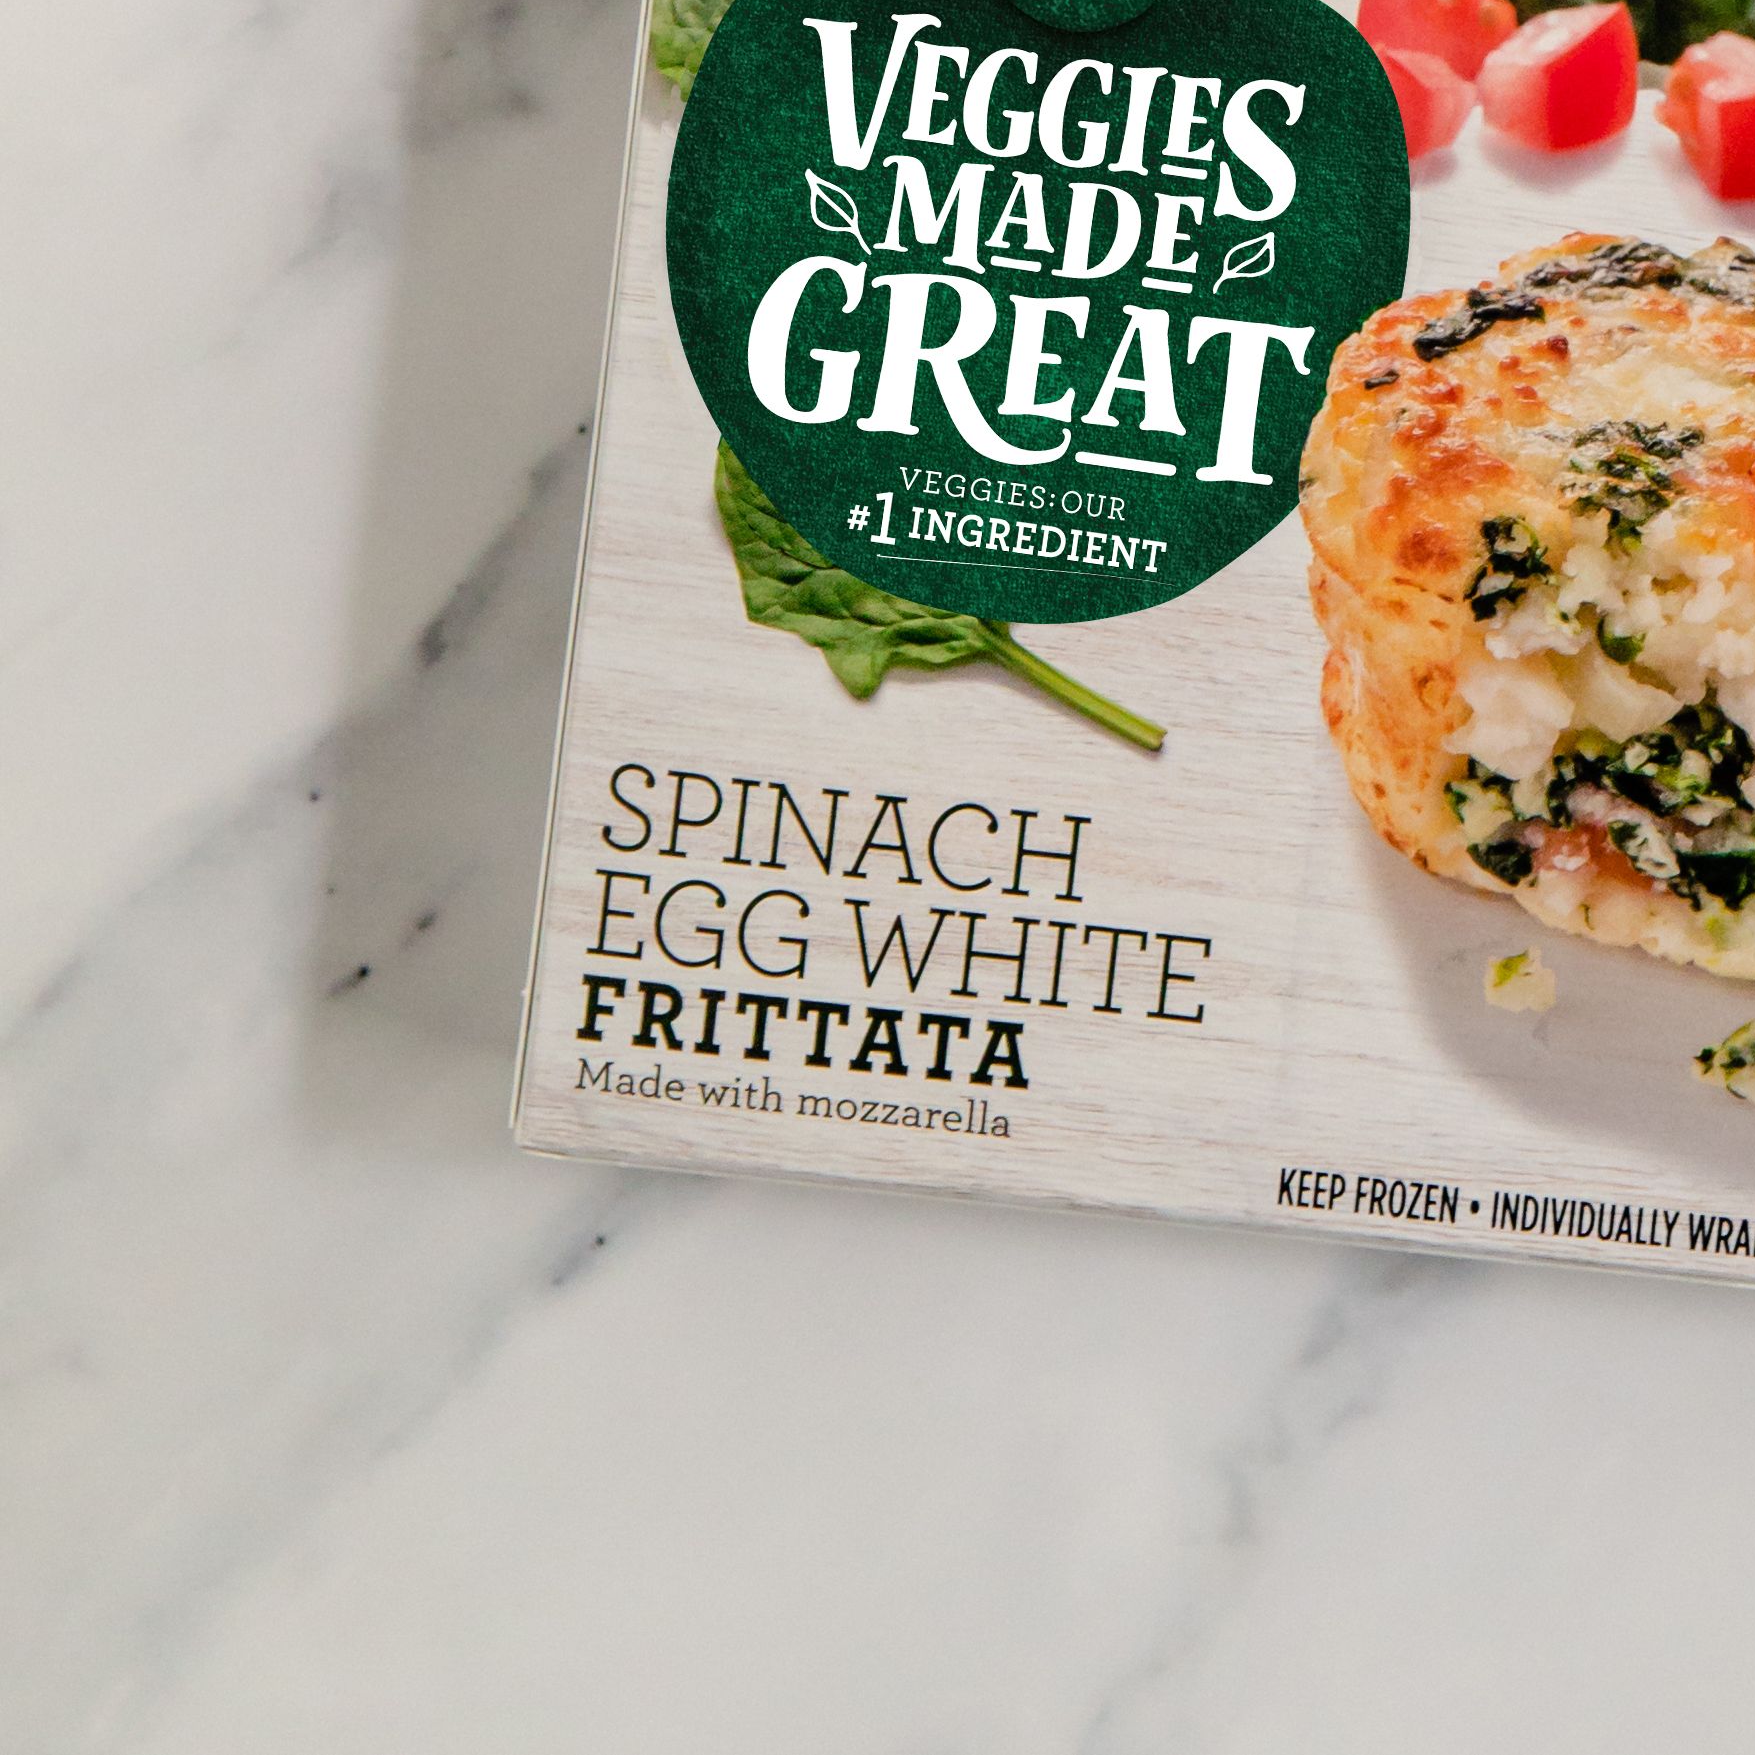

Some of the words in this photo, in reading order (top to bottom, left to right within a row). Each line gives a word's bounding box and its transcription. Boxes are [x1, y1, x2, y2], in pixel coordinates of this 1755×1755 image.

[802, 13, 1306, 222] VEGGIES
[873, 155, 1205, 293] MADE
[746, 255, 1315, 486] GREAT
[846, 490, 898, 546] #1
[909, 506, 1167, 574] INGREDIENT
[602, 763, 1091, 903] SPINACH
[586, 868, 810, 979] EGG
[843, 898, 1212, 1024] WHITE
[575, 1057, 686, 1101] Made
[698, 1076, 783, 1113] with
[797, 1091, 1011, 1138] mozzarella
[576, 973, 1029, 1089] FRITTATA
[1277, 1168, 1346, 1213] KEEP
[1354, 1176, 1459, 1223] FROZEN
[1491, 1191, 1680, 1247] INDIVIDUALLY
